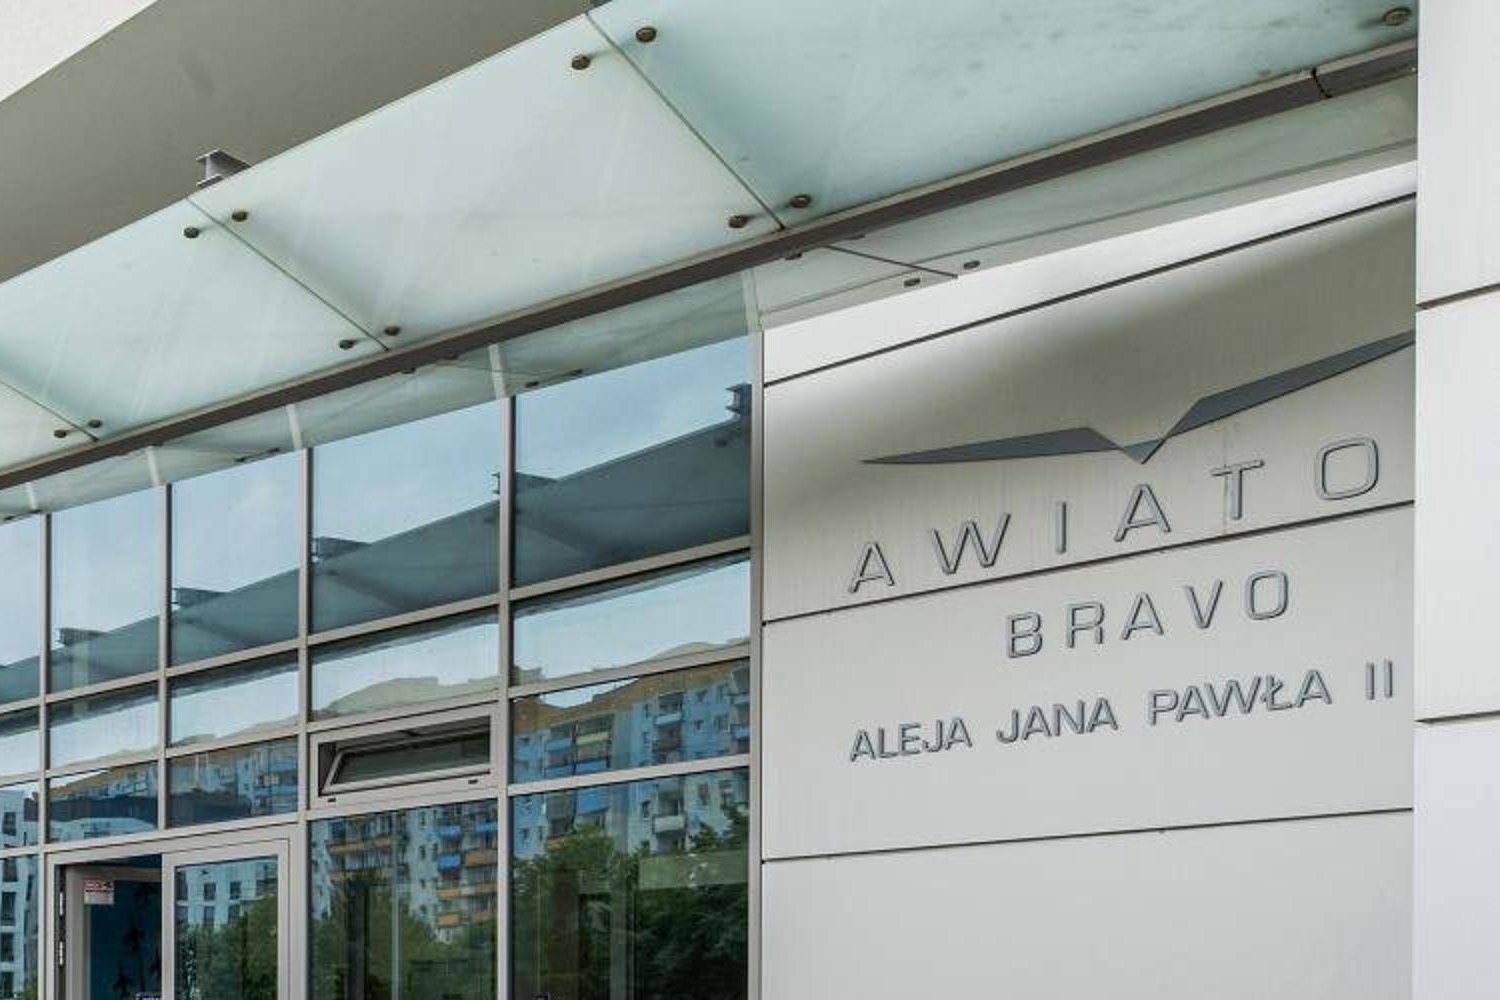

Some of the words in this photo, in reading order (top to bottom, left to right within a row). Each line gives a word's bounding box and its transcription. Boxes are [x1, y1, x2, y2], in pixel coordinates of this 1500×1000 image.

[1007, 570, 1290, 659] BRAVO
[849, 715, 972, 763] ALEJA
[996, 696, 1118, 744] JANA
[1148, 668, 1332, 725] PAWŁA
[1366, 660, 1395, 701] II
